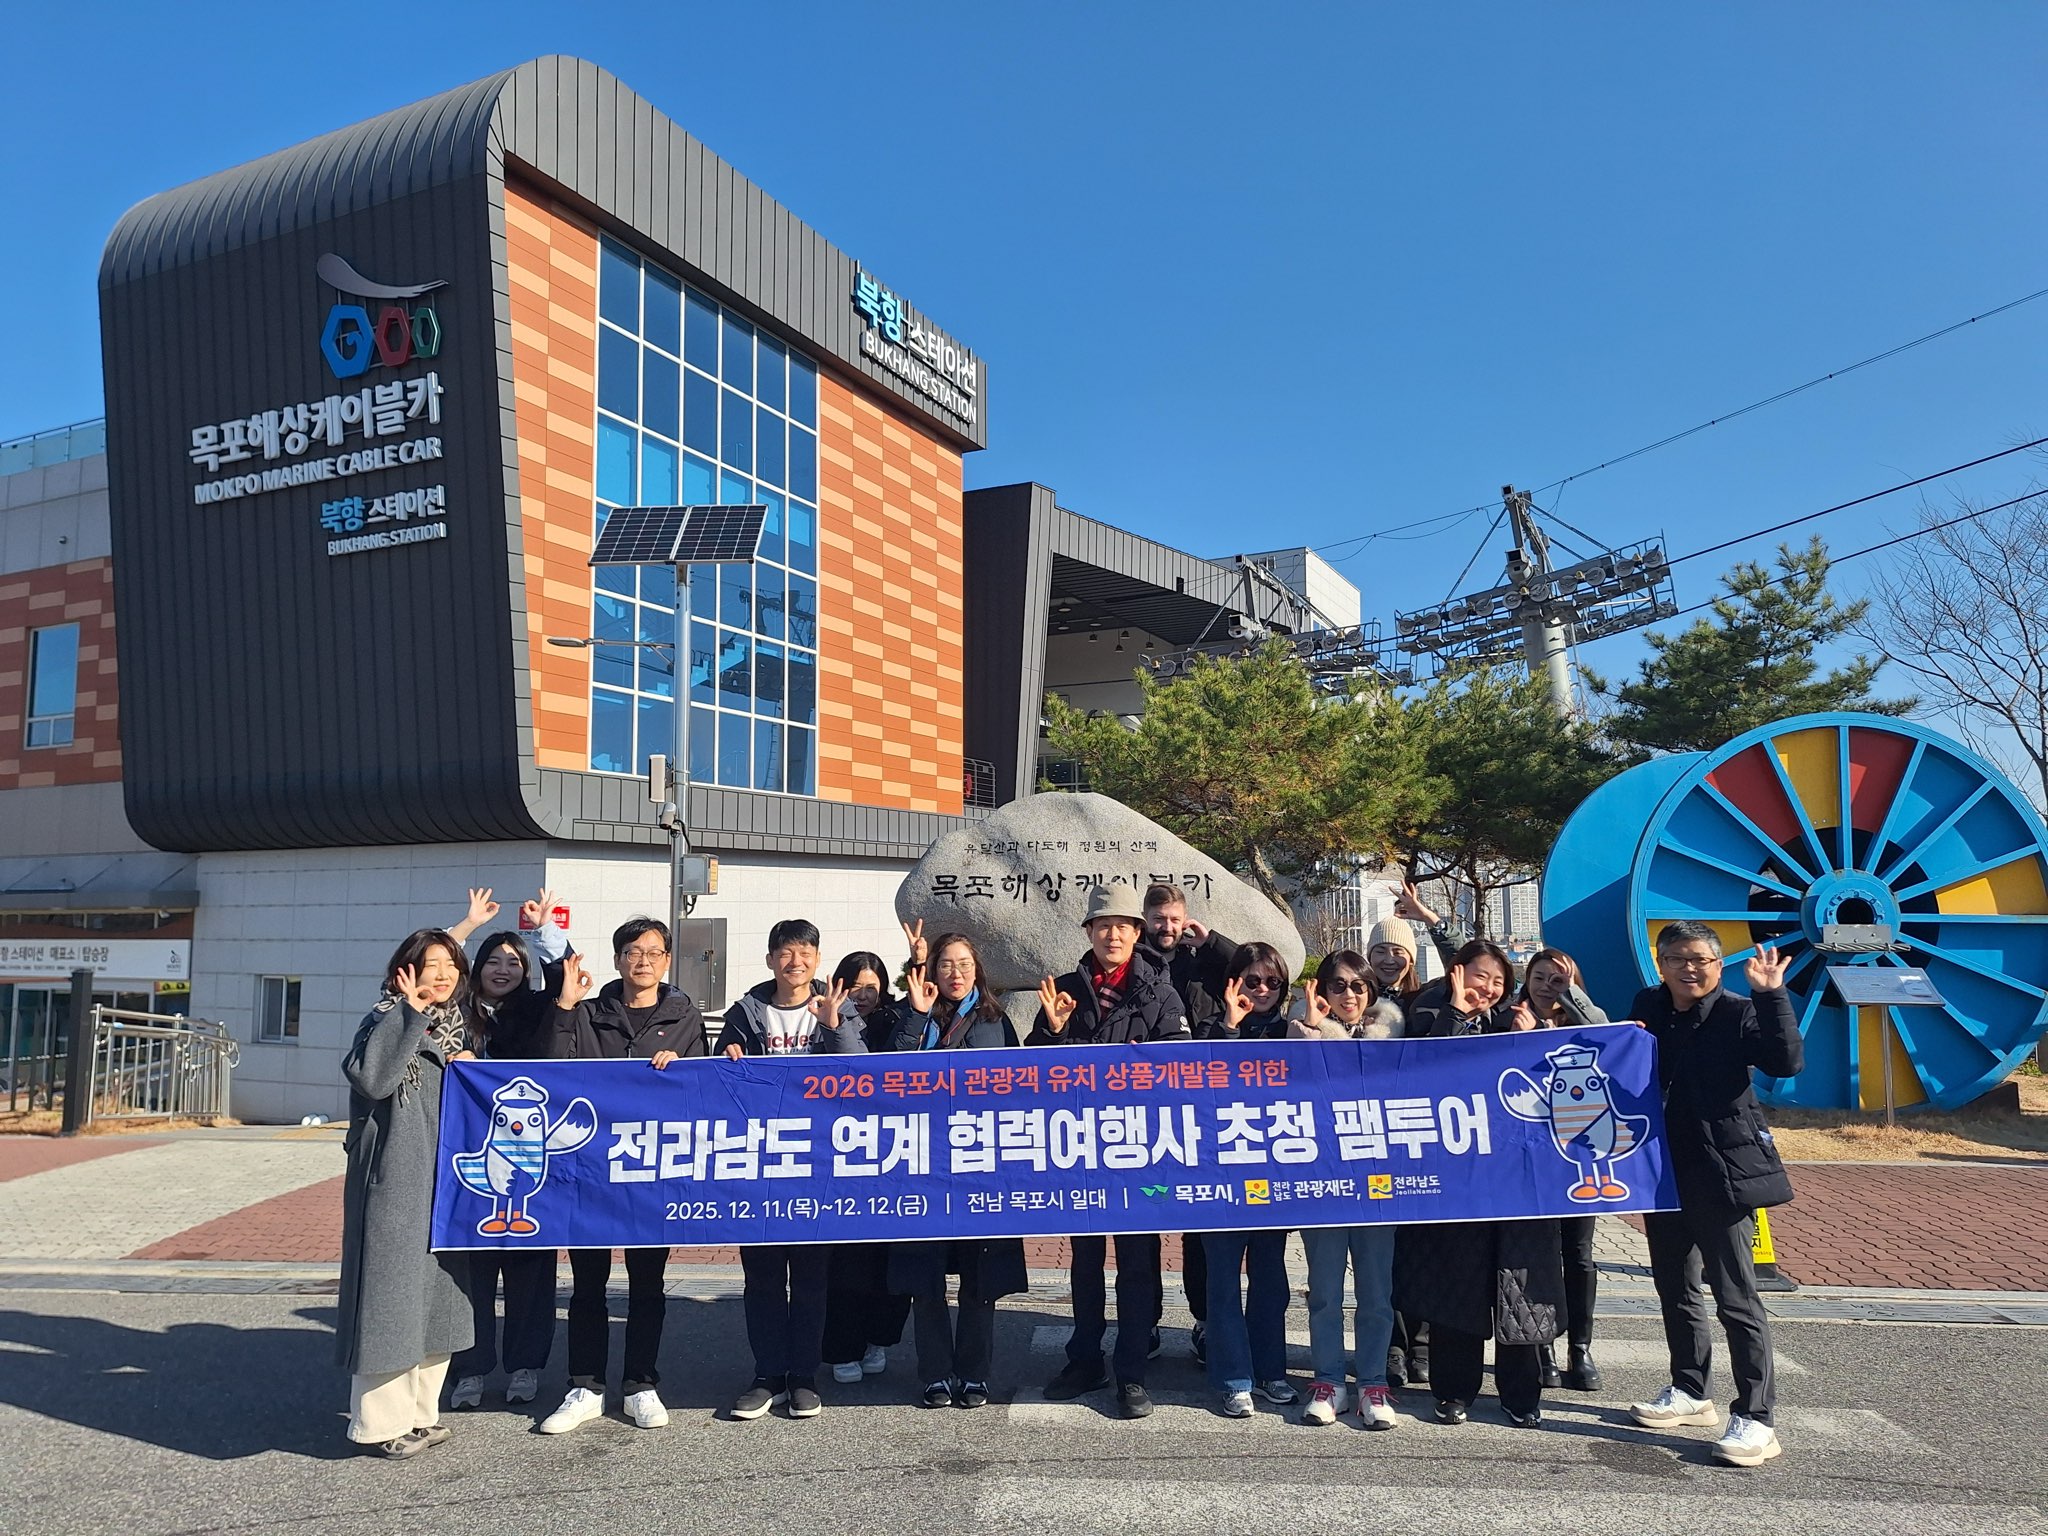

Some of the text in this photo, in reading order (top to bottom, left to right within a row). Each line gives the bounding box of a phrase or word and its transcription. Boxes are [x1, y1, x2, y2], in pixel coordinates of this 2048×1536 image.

[855, 272, 976, 397] 북항 스테이션
[864, 331, 976, 424] BUKHANG STATION
[189, 371, 444, 472] 목포해상케이블카
[195, 437, 443, 504] MOKPO MARINE CABLE CAR
[320, 485, 446, 533] 북항 스테이션
[328, 522, 446, 556] BUKHANG STATION
[964, 840, 1157, 855] 유달산과 다도해 정원의 산책
[11, 946, 44, 961] 스테이션
[50, 946, 75, 960] 매표소
[82, 946, 109, 962] 탑승장
[768, 1031, 816, 1048] ickies
[804, 1059, 1290, 1099] 2026 목포시 관광객 유치 상품개발을 위한
[608, 1094, 1492, 1183] 전라남도 연계 협력여행사 초청 팸투어
[1272, 1181, 1290, 1192] 전라
[1273, 1192, 1292, 1202] 남도
[1293, 1179, 1361, 1200] 관광재단,
[1393, 1175, 1440, 1189] 전라남도
[665, 1202, 723, 1221] 2025.
[729, 1201, 757, 1219] 12.
[868, 1195, 928, 1217] 12.(금)
[967, 1194, 1002, 1213] 전남
[1009, 1191, 1064, 1212] 목포시
[1070, 1188, 1107, 1210] 일대
[1175, 1183, 1240, 1206] 목포시,
